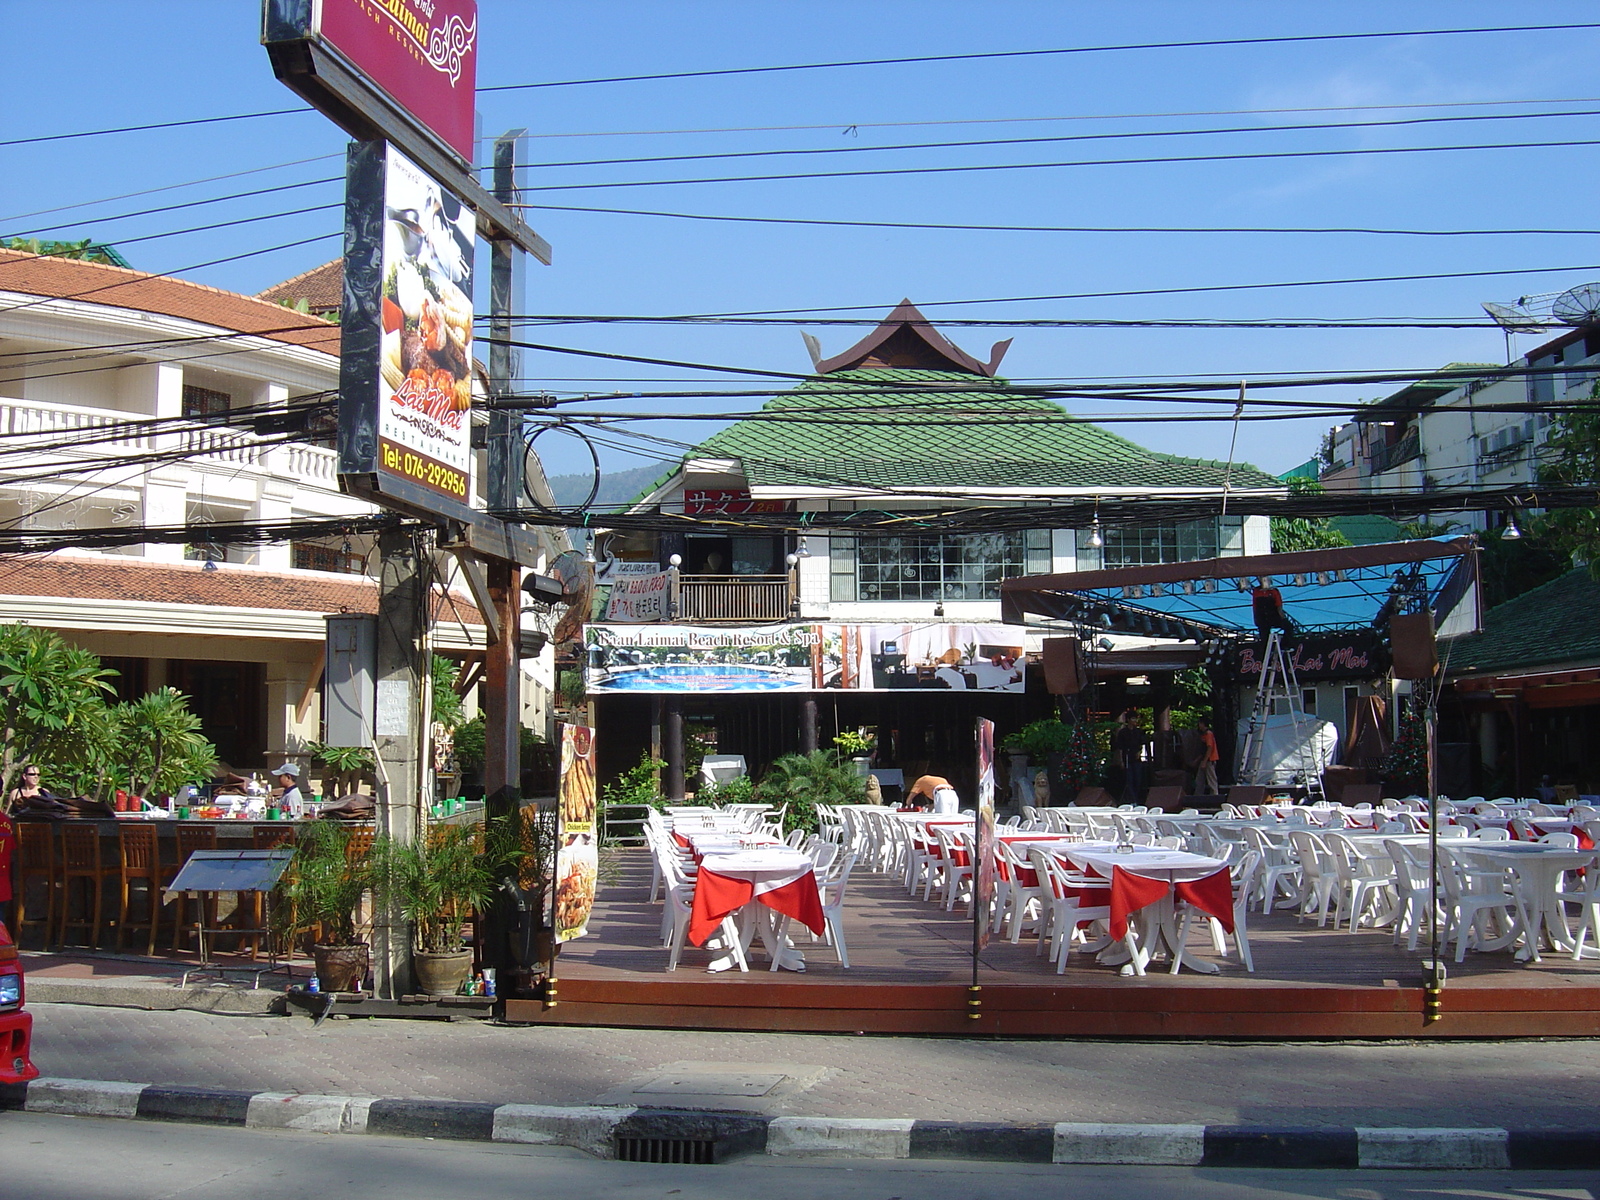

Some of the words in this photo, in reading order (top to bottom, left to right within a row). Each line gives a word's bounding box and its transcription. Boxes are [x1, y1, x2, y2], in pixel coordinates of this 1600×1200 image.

[388, 24, 424, 66] RESORT
[390, 378, 426, 414] Lai
[427, 389, 465, 431] Mai
[384, 423, 465, 467] RESTAURANT
[382, 443, 402, 471] Tel:
[404, 453, 466, 496] 076-292956
[599, 631, 635, 646] Baan
[638, 632, 685, 646] Laimai
[688, 632, 730, 646] Beach
[733, 632, 776, 646] Resort
[780, 630, 791, 645] &
[795, 630, 819, 647] Spa
[1292, 643, 1324, 671] Lai
[1328, 646, 1368, 670] Mai
